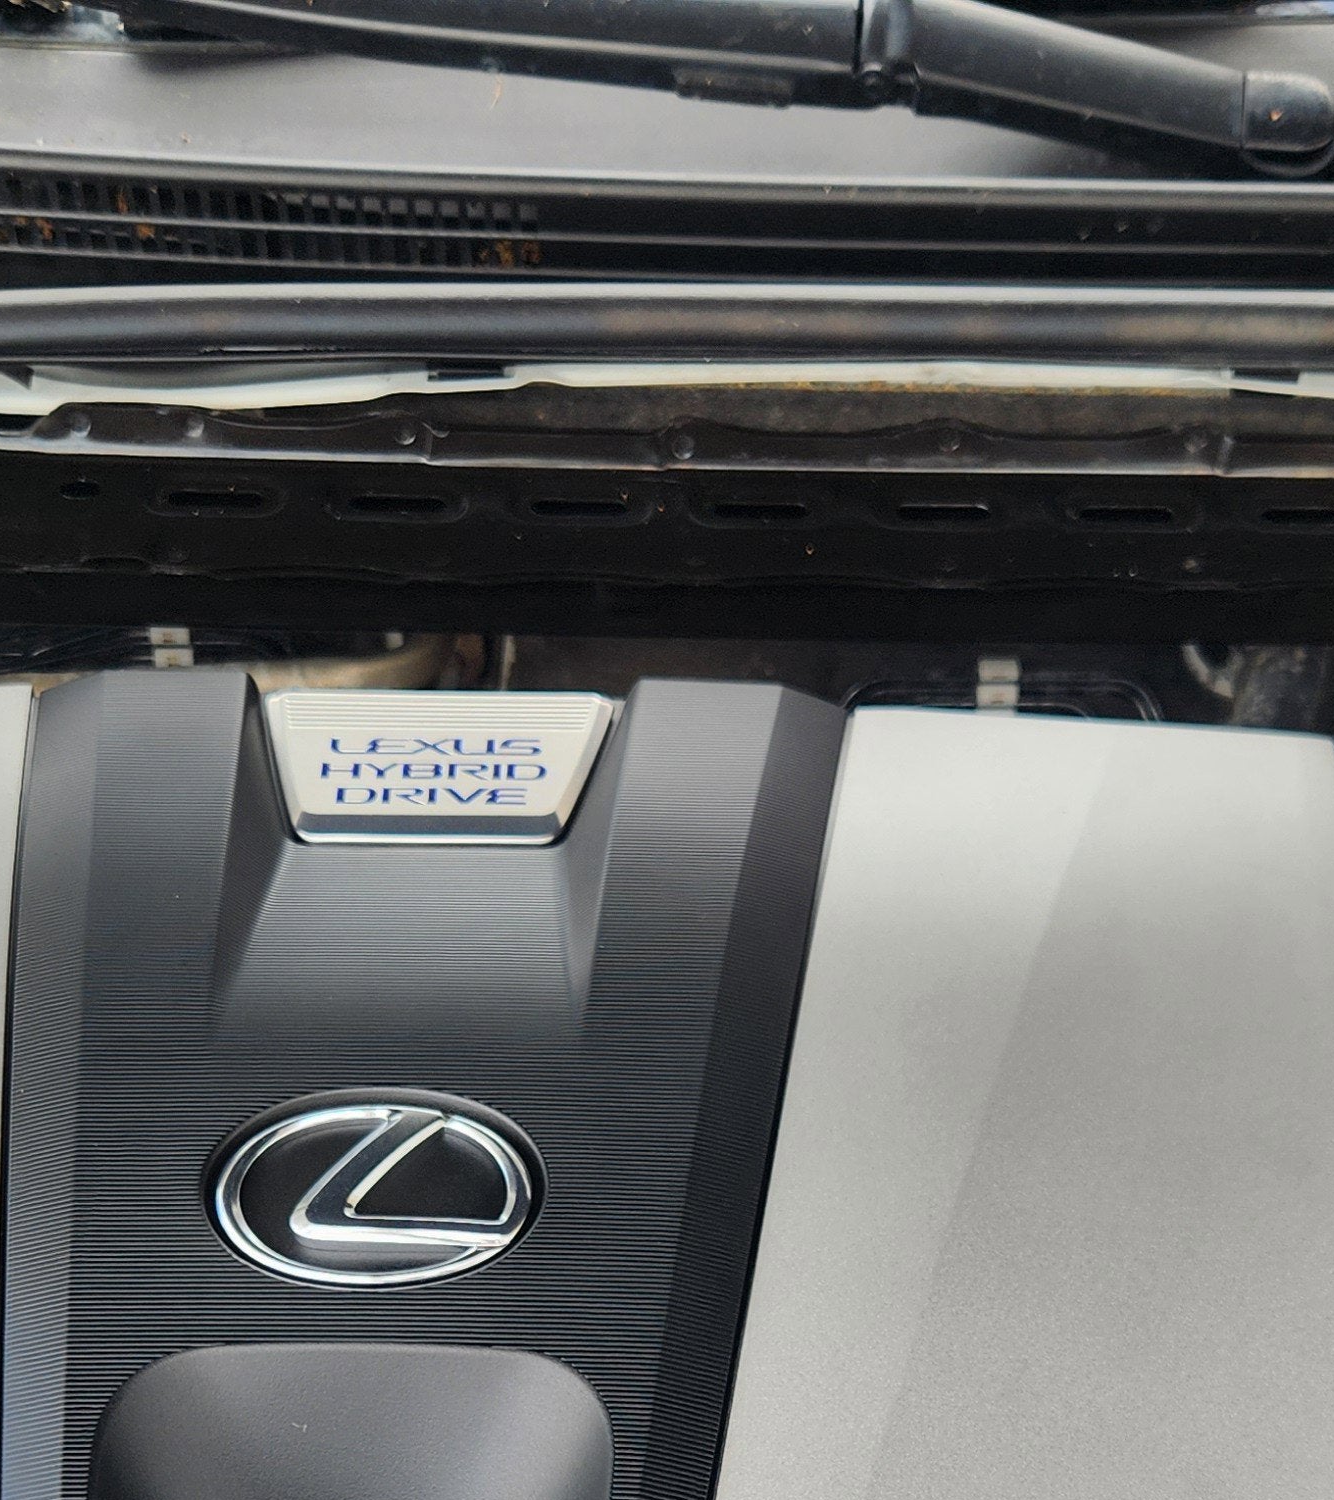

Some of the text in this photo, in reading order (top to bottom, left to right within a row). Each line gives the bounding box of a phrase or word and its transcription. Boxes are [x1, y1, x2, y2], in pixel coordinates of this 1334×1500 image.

[329, 737, 543, 757] LEXUS
[319, 762, 548, 782] HYBRID
[334, 787, 528, 807] DRIVE
